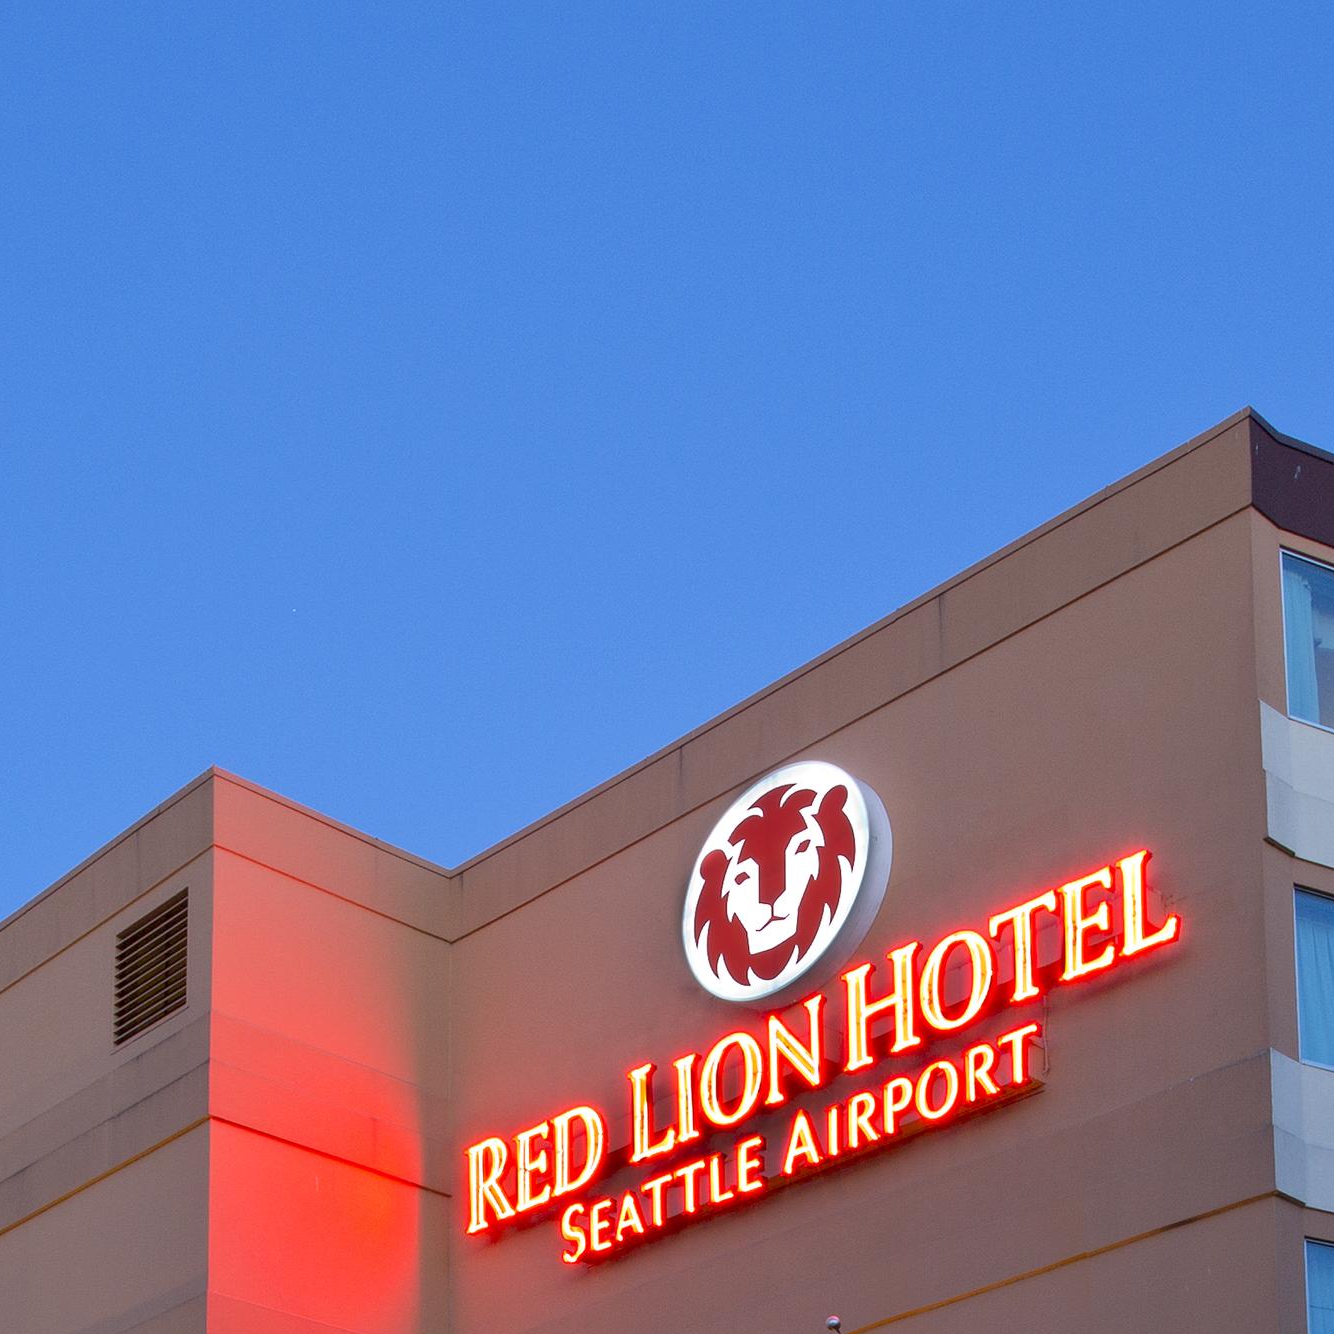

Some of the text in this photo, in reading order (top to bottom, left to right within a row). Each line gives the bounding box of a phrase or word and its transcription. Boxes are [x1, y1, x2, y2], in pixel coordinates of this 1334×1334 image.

[465, 848, 1181, 1235] RED LION HOTEL
[559, 1022, 1041, 1265] SEATTLE AIRPORT
